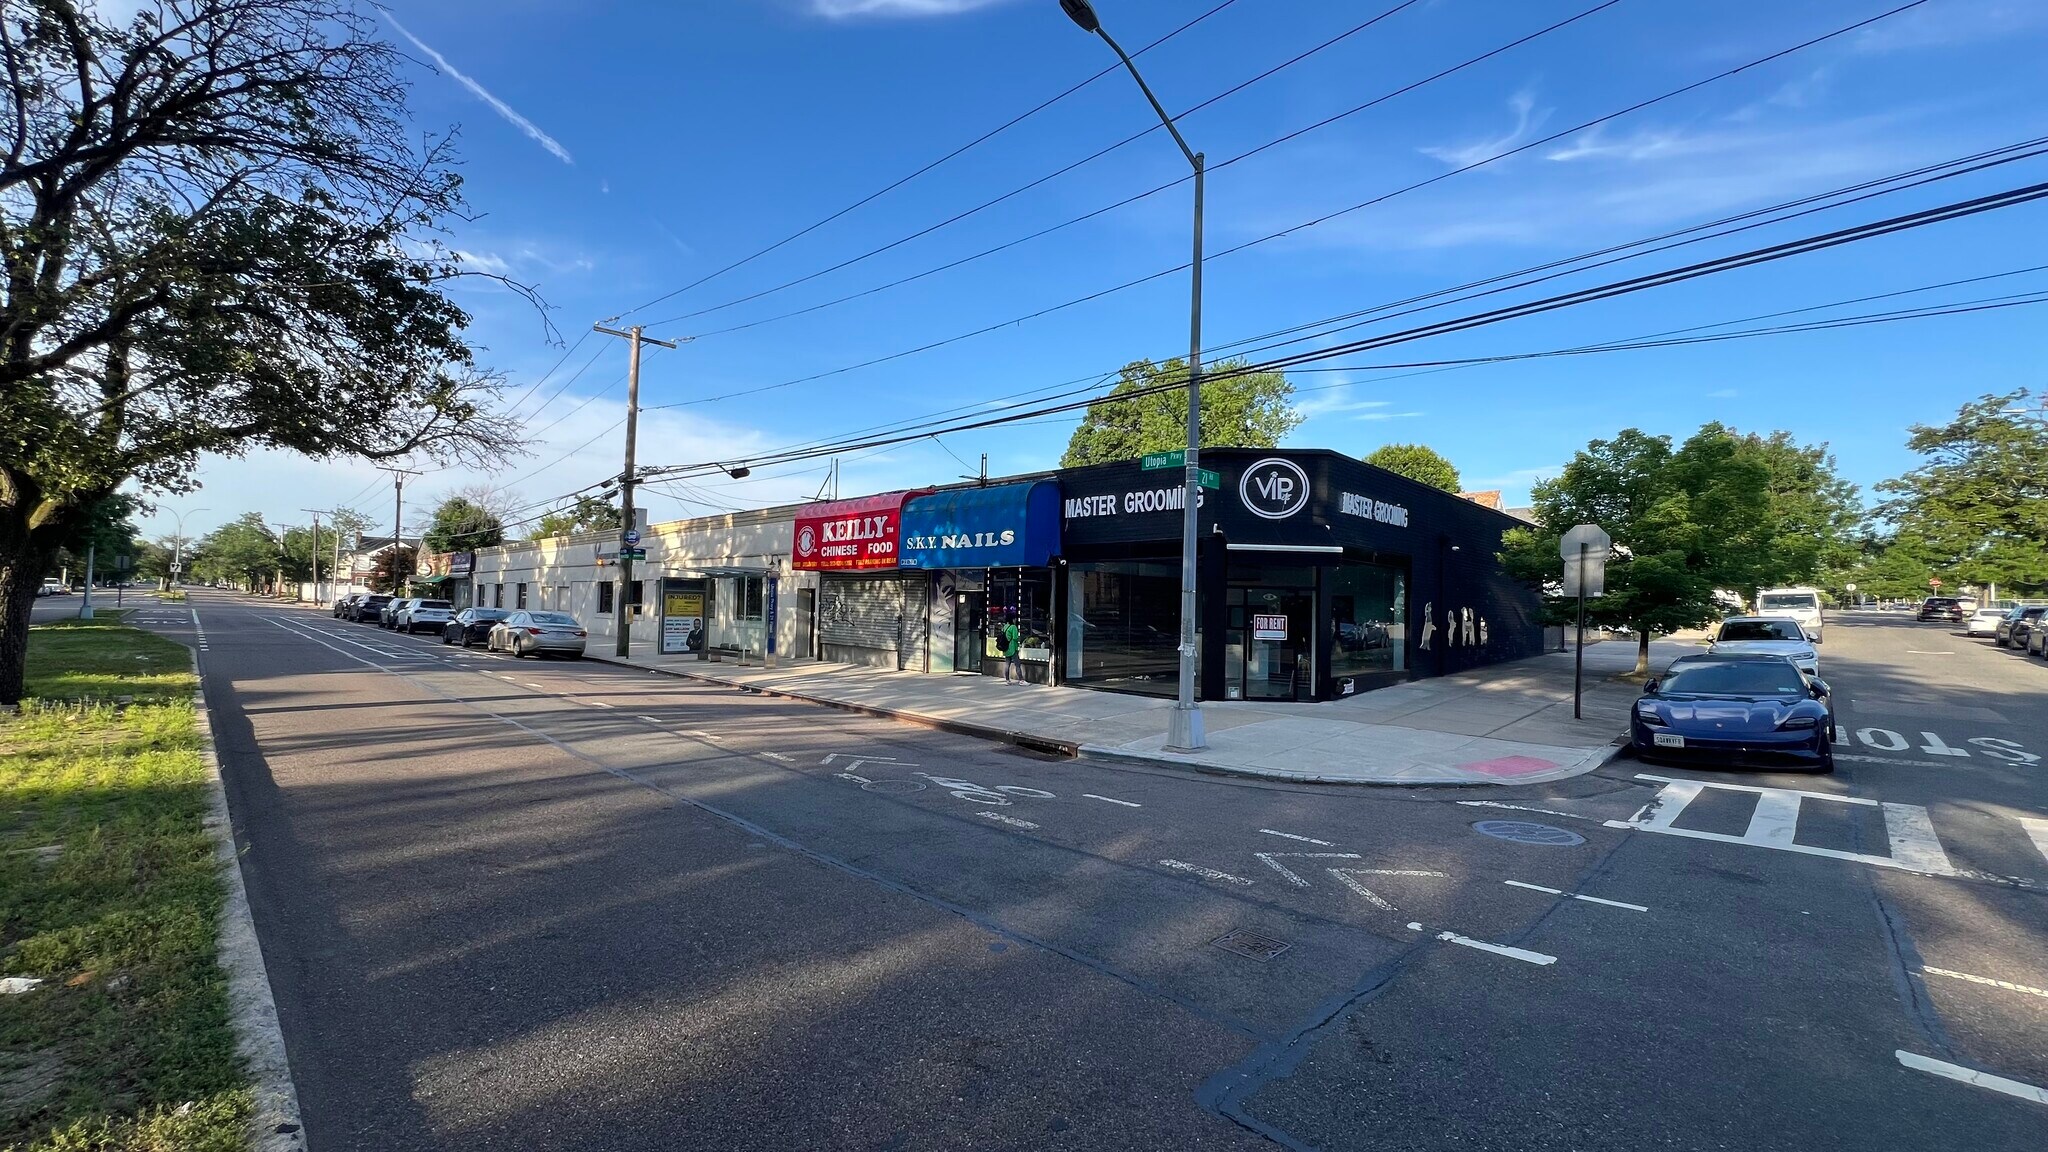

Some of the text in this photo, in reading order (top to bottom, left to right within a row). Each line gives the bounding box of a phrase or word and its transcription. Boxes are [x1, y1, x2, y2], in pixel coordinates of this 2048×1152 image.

[1145, 452, 1183, 469] Utopia Pkwy
[1201, 472, 1208, 484] 21
[1065, 495, 1117, 518] MASTER
[1341, 492, 1373, 520] MASTER
[822, 516, 888, 542] KEILLY
[941, 530, 1015, 549] NAILS
[821, 542, 893, 557] CHINESE FOOD
[1256, 617, 1285, 630] FOR RENT
[1834, 725, 2042, 762] STO
